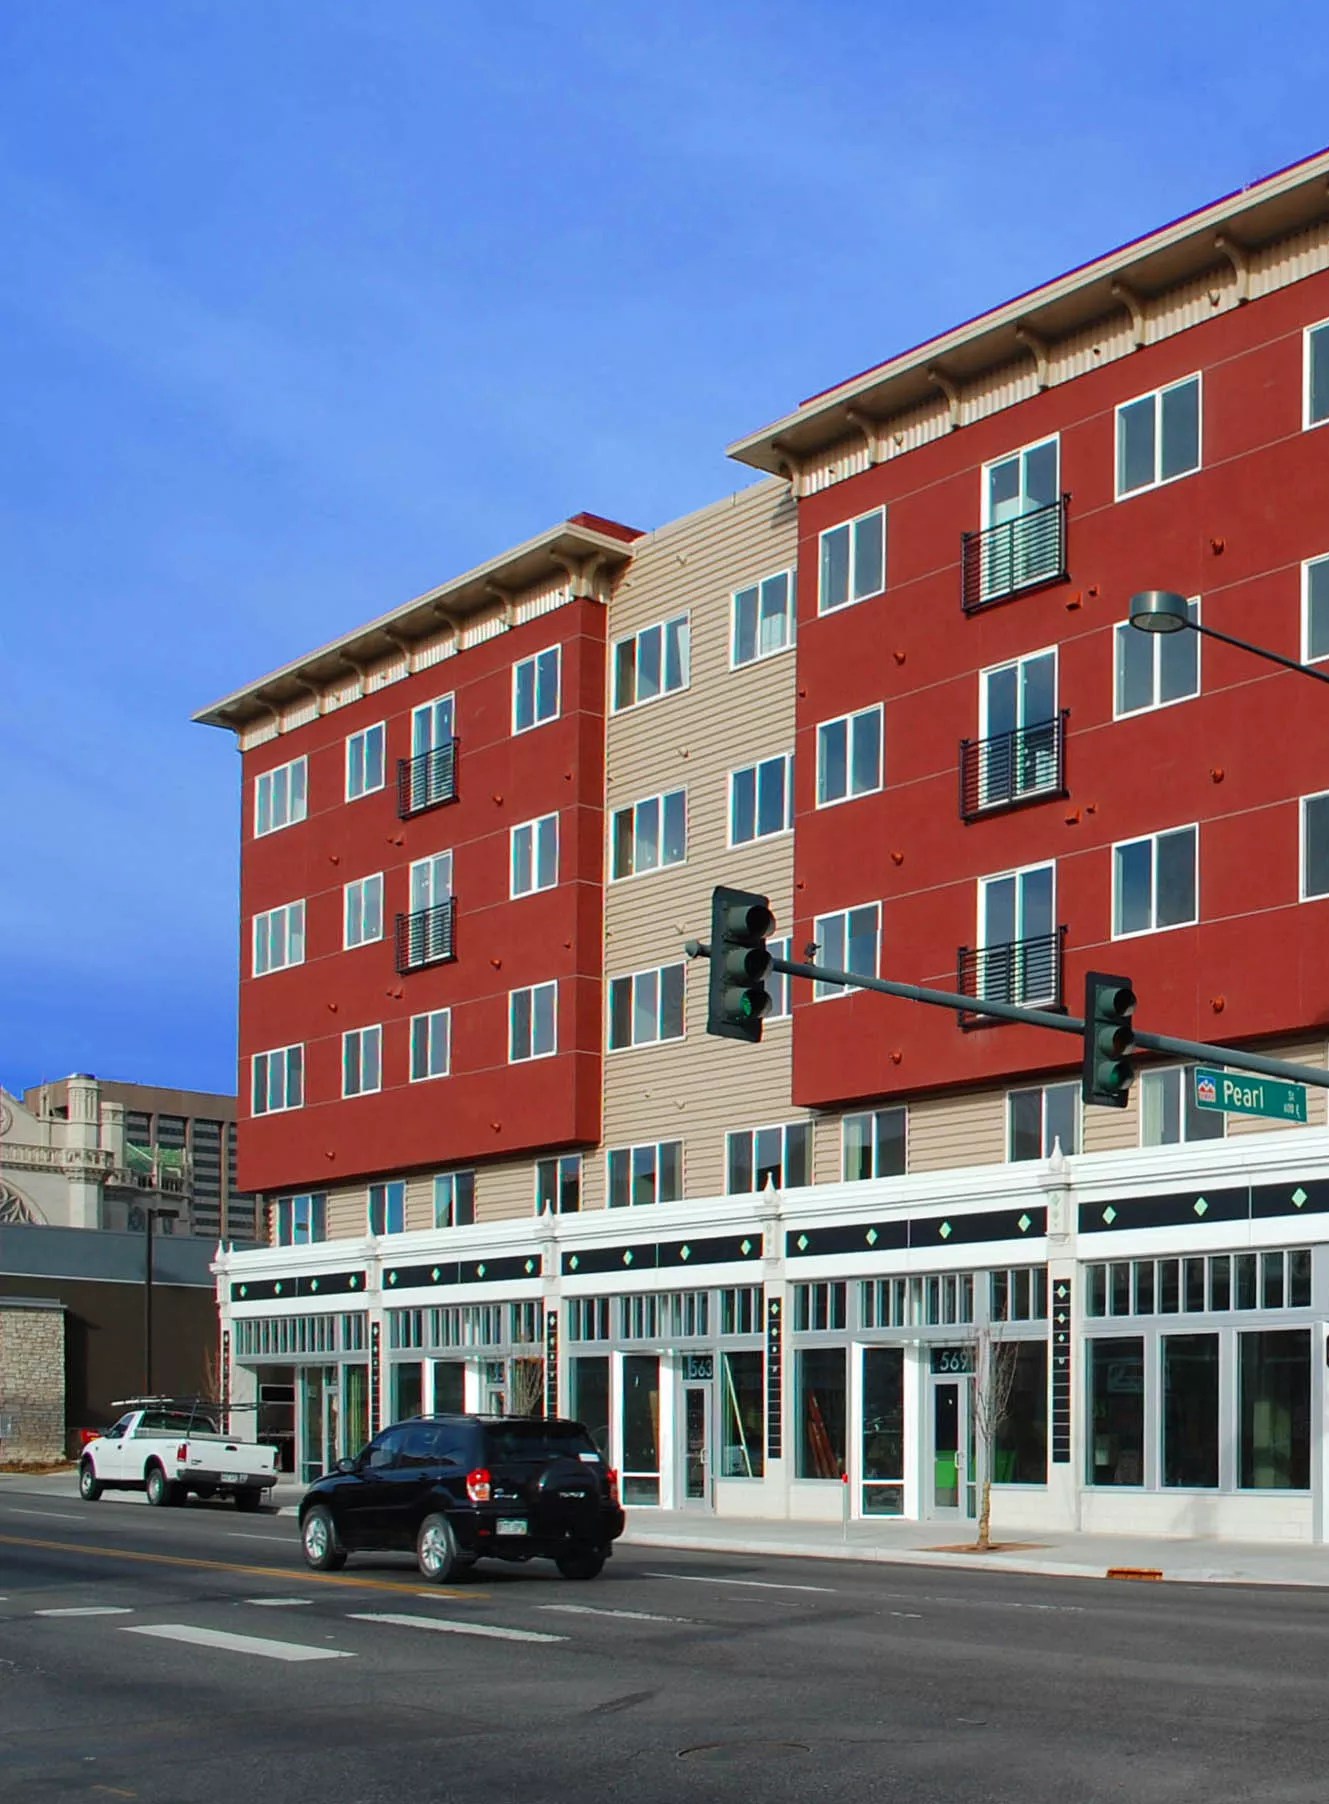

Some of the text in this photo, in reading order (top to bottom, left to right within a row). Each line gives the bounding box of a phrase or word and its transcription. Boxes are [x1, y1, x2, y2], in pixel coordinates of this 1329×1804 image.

[1223, 1080, 1264, 1109] Pearl
[690, 1359, 713, 1377] 563
[940, 1351, 968, 1370] 569
